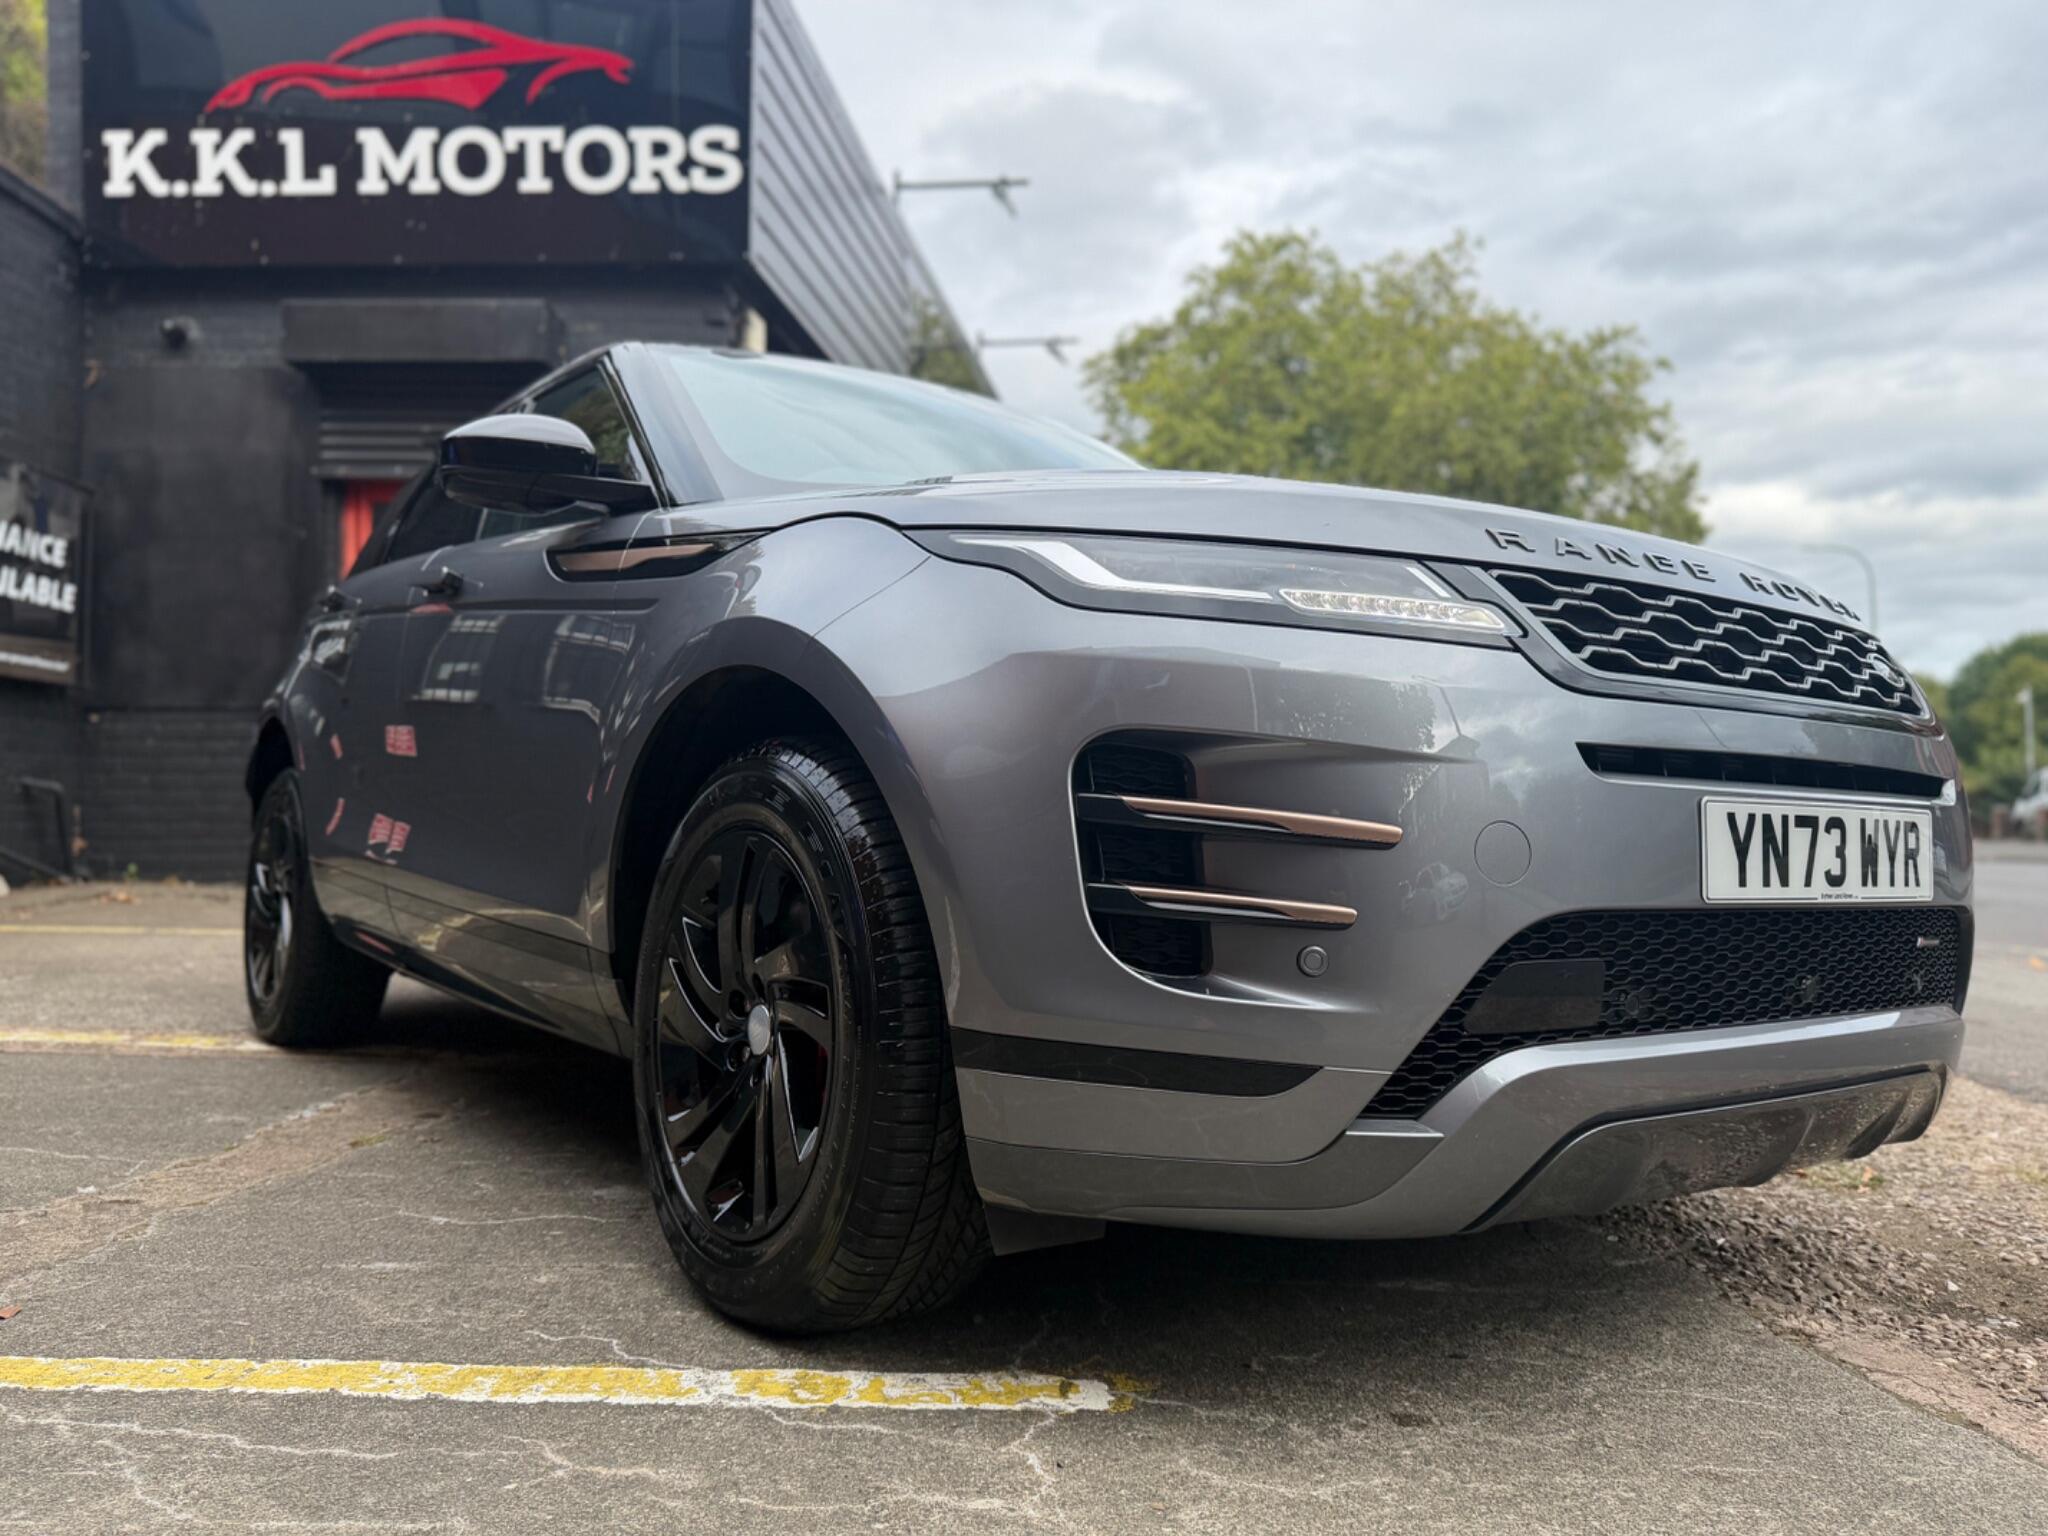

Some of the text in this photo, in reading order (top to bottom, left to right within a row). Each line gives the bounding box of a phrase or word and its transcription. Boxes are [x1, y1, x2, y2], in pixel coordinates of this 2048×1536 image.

[101, 125, 744, 198] K.K.L MOTORS
[1485, 528, 1717, 583] RANGE
[1727, 812, 1921, 888] YN73 WYR
